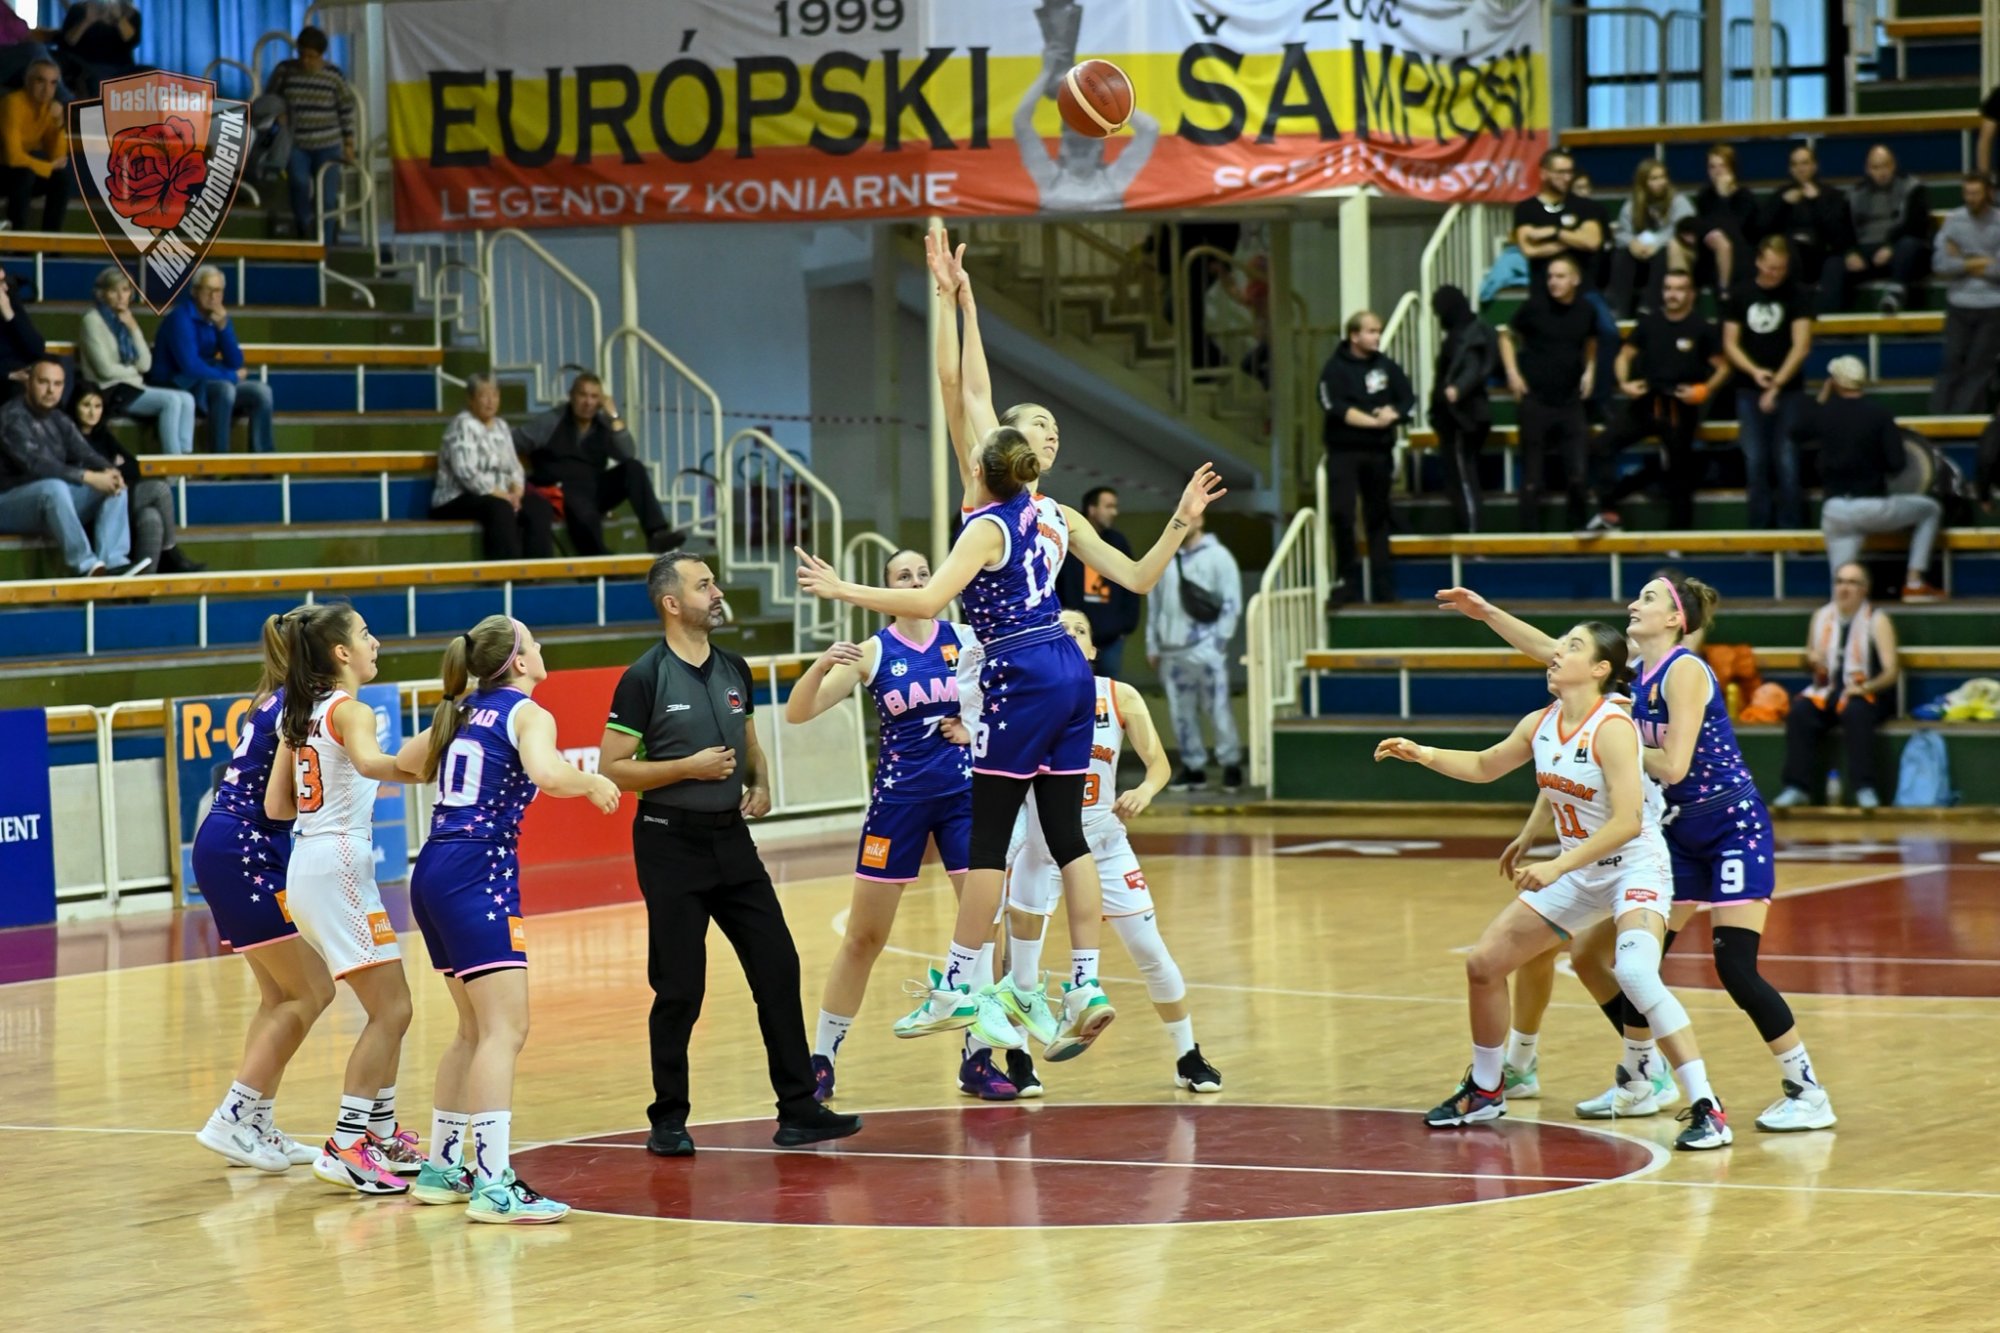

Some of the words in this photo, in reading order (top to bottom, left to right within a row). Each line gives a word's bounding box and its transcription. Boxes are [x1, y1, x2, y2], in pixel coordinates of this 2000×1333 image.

[774, 0, 905, 37] 1999
[427, 28, 991, 169] EURÓPSKI
[440, 183, 651, 222] LEGENDY
[664, 184, 691, 213] Z
[703, 172, 959, 214] KONIARNE
[883, 676, 960, 717] BAM
[291, 744, 325, 814] 3
[1552, 802, 1589, 839] 11
[1597, 854, 1623, 868] scp
[1720, 858, 1744, 894] 9
